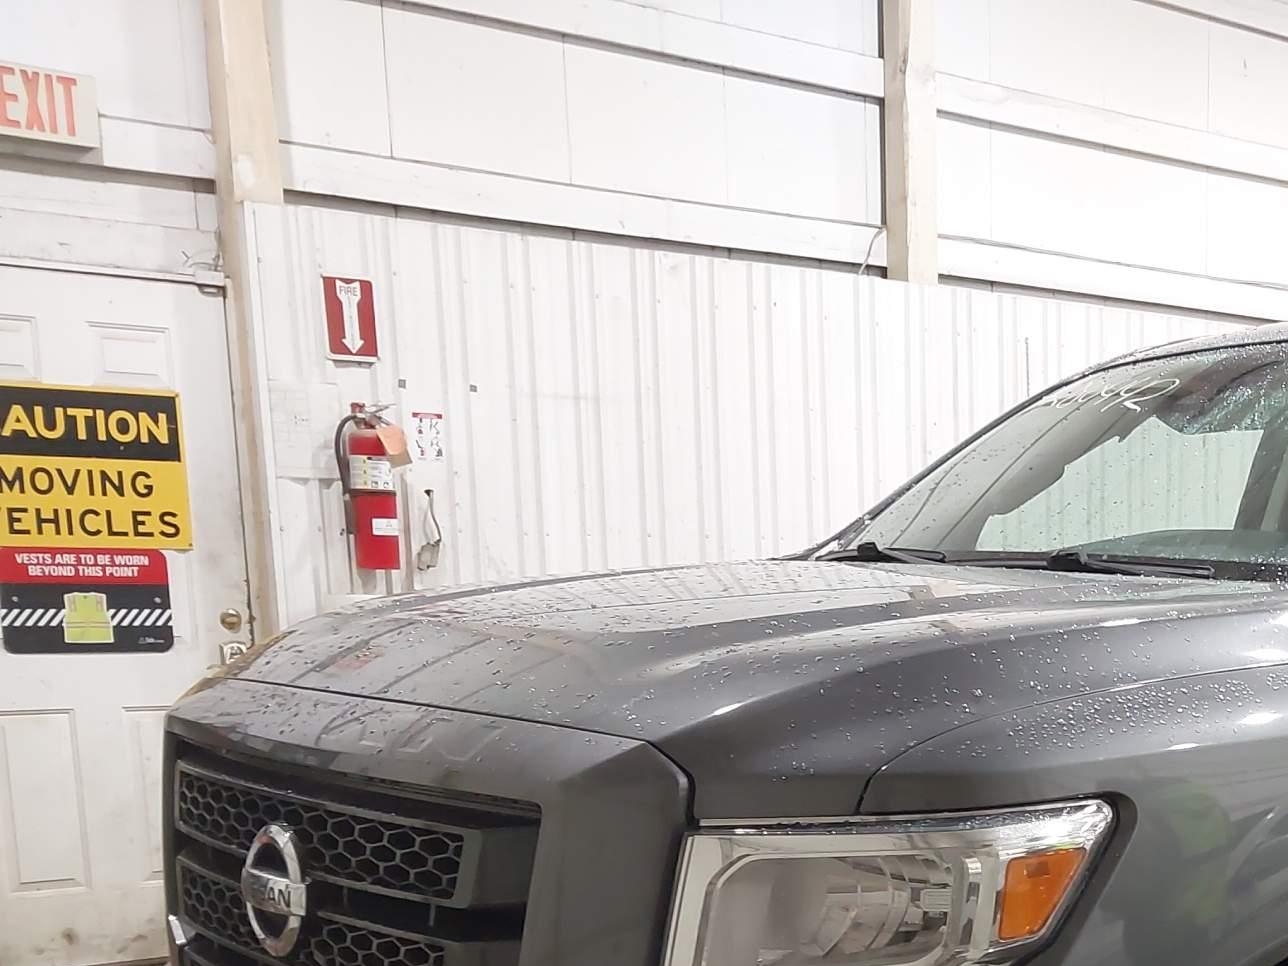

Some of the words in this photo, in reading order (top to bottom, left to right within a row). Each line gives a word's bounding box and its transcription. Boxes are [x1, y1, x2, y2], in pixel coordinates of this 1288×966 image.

[0, 65, 77, 137] EXIT
[339, 286, 358, 297] FIRE
[1, 404, 169, 444] AUTION
[0, 466, 154, 498] MOVING
[0, 507, 181, 538] EHICLES
[15, 553, 52, 564] VESTS
[55, 554, 77, 564] ARE
[79, 555, 94, 565] TO
[97, 555, 111, 565] BE
[113, 555, 149, 566] WORN
[28, 565, 75, 576] BEYOND
[78, 566, 102, 576] THIS
[106, 566, 139, 577] POINT
